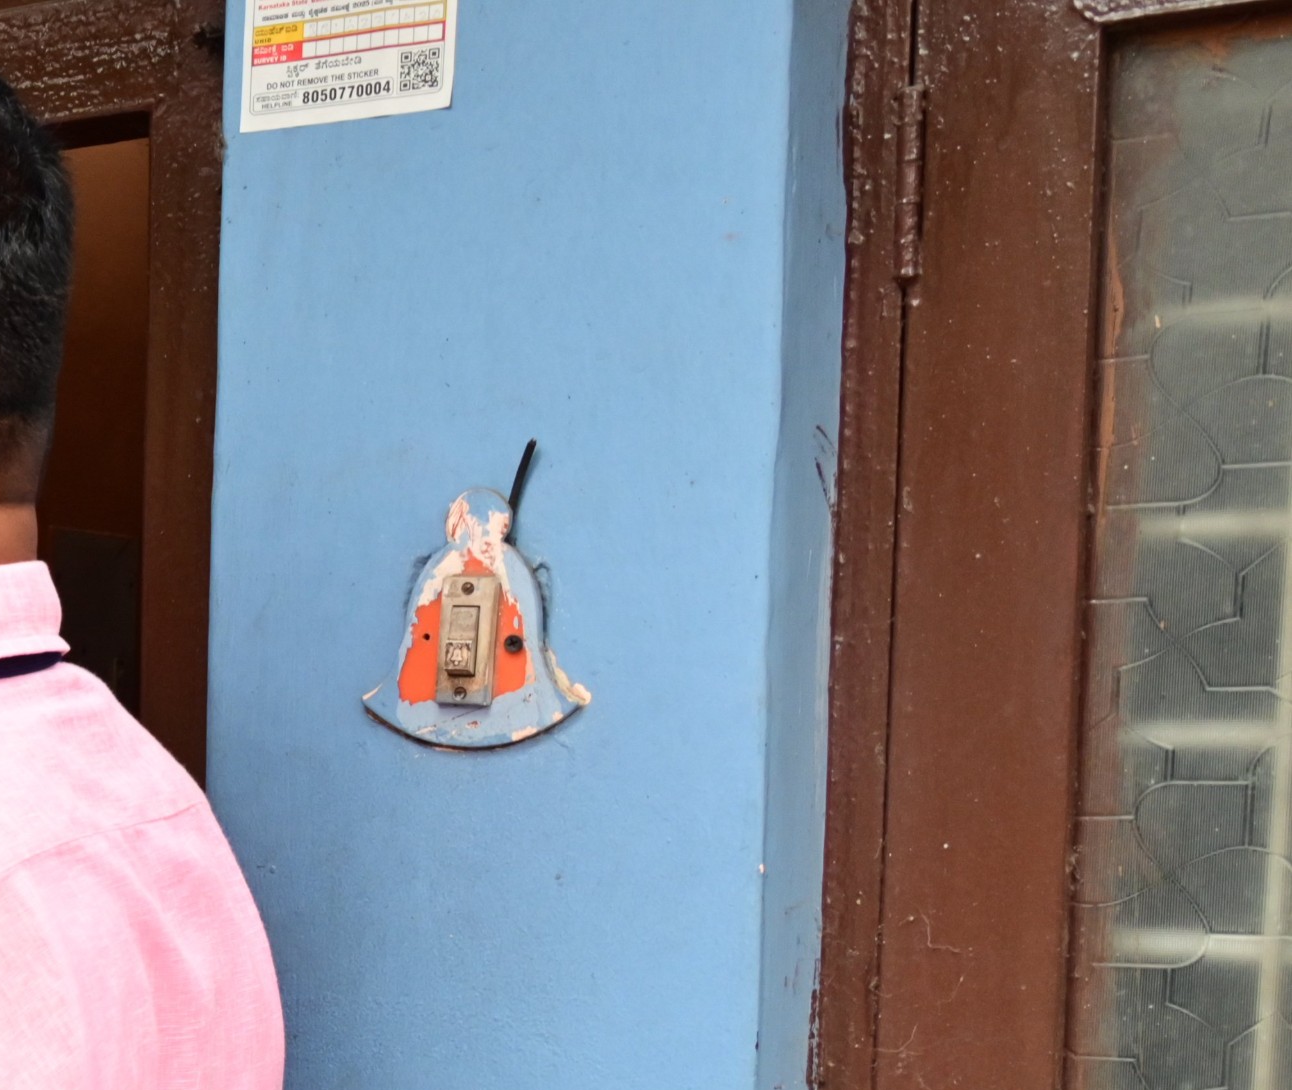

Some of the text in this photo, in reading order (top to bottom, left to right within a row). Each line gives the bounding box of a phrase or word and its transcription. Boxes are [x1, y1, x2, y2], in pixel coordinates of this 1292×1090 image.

[254, 55, 279, 65] SURVEY
[266, 68, 379, 90] DO NOT REMOVE THE STICKER
[302, 80, 391, 104] 8050770004
